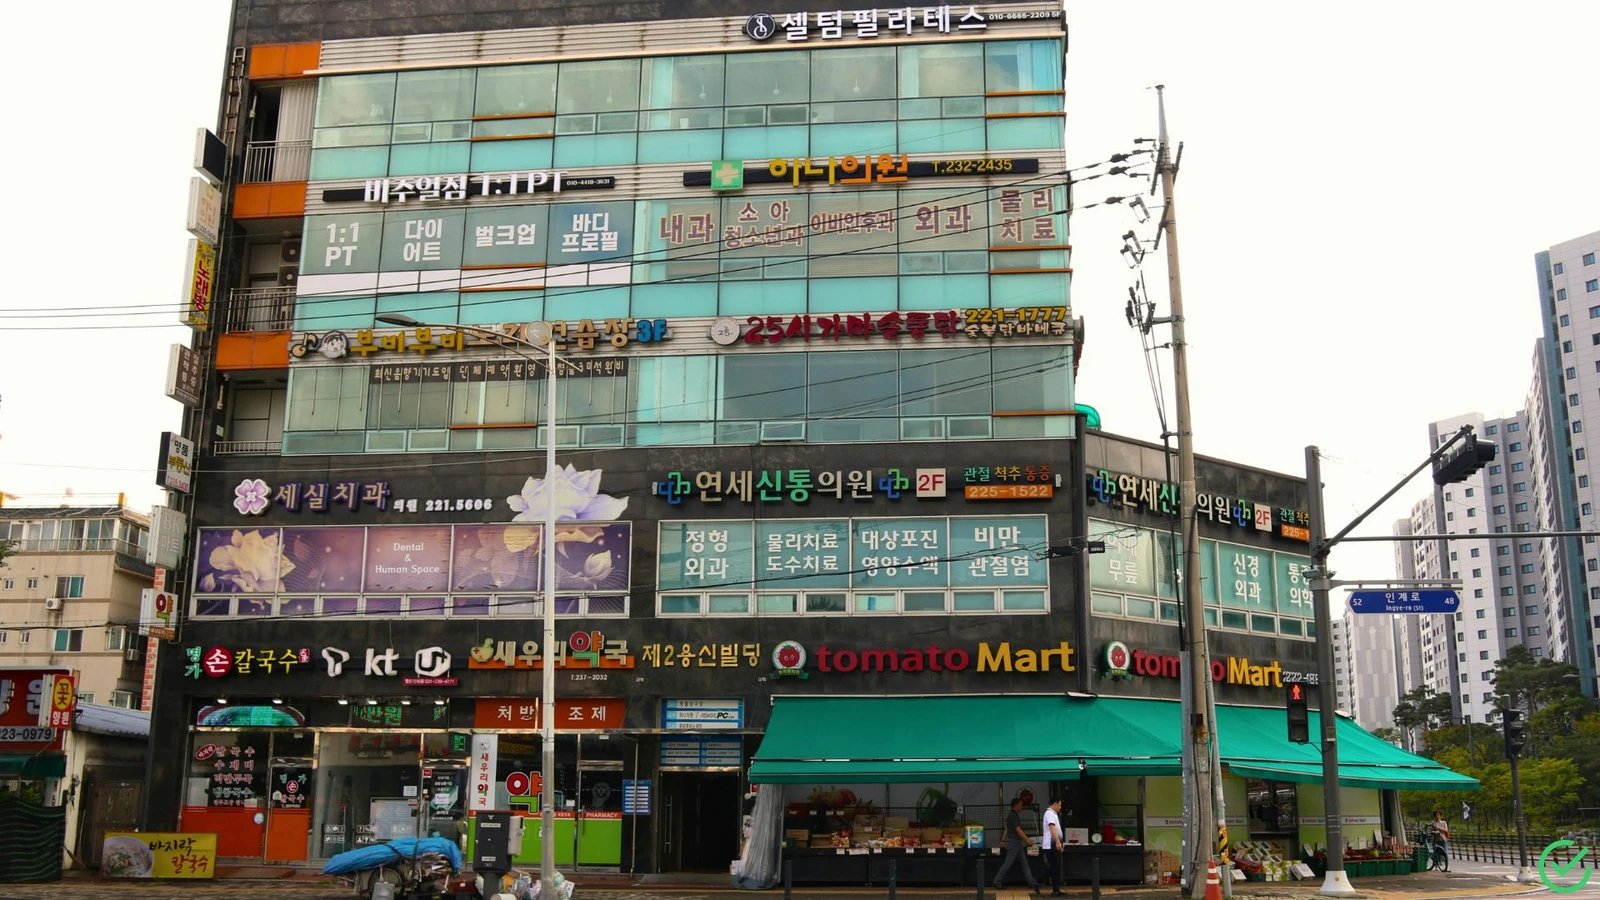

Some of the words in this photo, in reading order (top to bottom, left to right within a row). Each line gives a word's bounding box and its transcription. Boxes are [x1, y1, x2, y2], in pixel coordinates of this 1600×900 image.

[780, 6, 987, 41] 셀텀필라테스
[769, 155, 908, 187] 하나의원
[931, 159, 1013, 175] T.232-2435
[364, 175, 468, 204] 비주얼짐
[999, 188, 1054, 214] 물리
[572, 212, 609, 232] 바디
[738, 200, 790, 222] 소아
[914, 204, 973, 234] 외과
[327, 222, 359, 243] 1:1
[404, 218, 443, 240] 다이
[475, 223, 537, 248] 벌크업
[659, 212, 714, 244] 내과
[809, 210, 897, 237] 이비인후과
[1000, 215, 1057, 243] 치료
[561, 231, 618, 253] 프로필
[722, 224, 804, 249] 청소년과
[325, 245, 357, 267] PT
[403, 241, 441, 263] 어트
[964, 306, 1067, 323] 221-1777
[351, 327, 465, 357] 부비부비
[636, 319, 667, 342] 3F
[174, 440, 189, 457] 명품
[168, 455, 191, 476] 부동산
[695, 468, 874, 503] 연세신통의원
[917, 476, 945, 493] 2F
[964, 466, 991, 482] 관절
[994, 466, 1021, 480] 척추
[1025, 465, 1052, 479] 통증
[969, 485, 1050, 498] 225-1522
[273, 481, 391, 510] 세실치과
[392, 499, 418, 513] 의원
[425, 498, 493, 513] 221.5606
[1118, 473, 1232, 525] 연세신의원
[1255, 510, 1271, 527] 2F
[1280, 507, 1295, 524] 관절
[163, 510, 181, 534] BK
[393, 542, 424, 552] Dental
[684, 531, 729, 554] 정형
[765, 533, 839, 553] 물리치료
[861, 529, 938, 550] 대상포진
[974, 526, 1021, 551] 비만
[375, 564, 408, 575] Human
[410, 565, 440, 577] Space
[403, 554, 412, 563] &
[684, 556, 729, 580] 외과
[765, 556, 839, 574] 도수치료
[861, 556, 939, 577] 영양수액
[968, 556, 1029, 577] 관절염
[1233, 553, 1259, 578] 신경
[1108, 559, 1138, 584] 무릎
[1234, 580, 1261, 604] 외과
[1353, 598, 1362, 606] 52
[1385, 592, 1421, 603] 인계로
[1444, 597, 1455, 605] 48
[156, 593, 174, 627] 약
[494, 631, 628, 667] 새우리약국
[642, 643, 760, 668] 제2용신빌딩
[815, 644, 969, 673] tomato
[976, 642, 1076, 672] Mart
[184, 646, 203, 680] 명가
[365, 648, 399, 676] kt
[1133, 649, 1225, 682] tomo
[1227, 655, 1283, 688] Mart
[570, 674, 608, 682] T.237-2032
[57, 682, 70, 706] 꽃
[53, 711, 70, 726] 향원
[498, 705, 535, 721] 처방
[568, 705, 607, 721] 조제
[0, 728, 52, 740] 23-0979
[478, 752, 489, 807] 새우리약국
[505, 772, 542, 815] 약
[148, 838, 196, 856] 바지락
[172, 854, 208, 875] 칼국수
